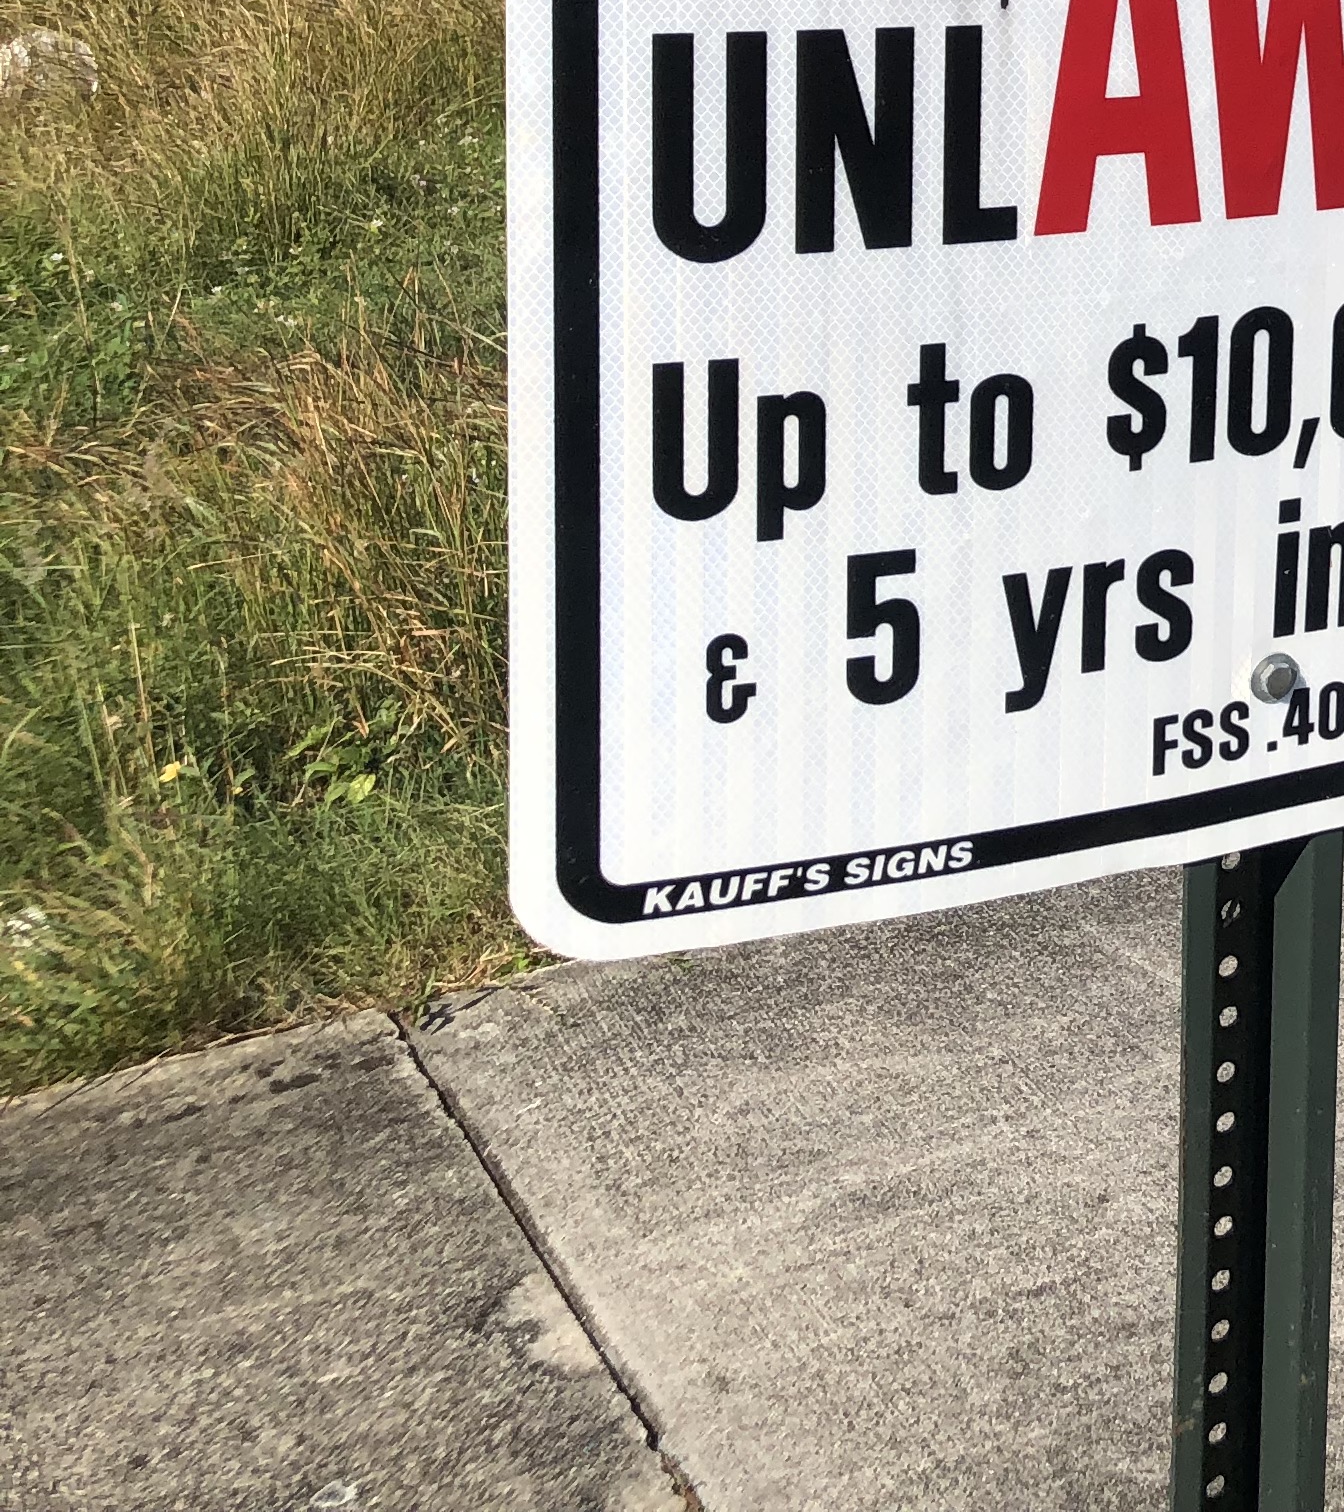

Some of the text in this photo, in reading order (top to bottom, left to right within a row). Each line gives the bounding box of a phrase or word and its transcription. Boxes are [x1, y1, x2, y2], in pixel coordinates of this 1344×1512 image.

[653, 358, 826, 542] Up
[907, 343, 1033, 495] to
[707, 634, 756, 723] &
[847, 549, 920, 705] 5
[1003, 549, 1193, 713] yrs
[1153, 701, 1249, 776] FSS
[642, 841, 974, 916] KAUFF'S SIGNS
